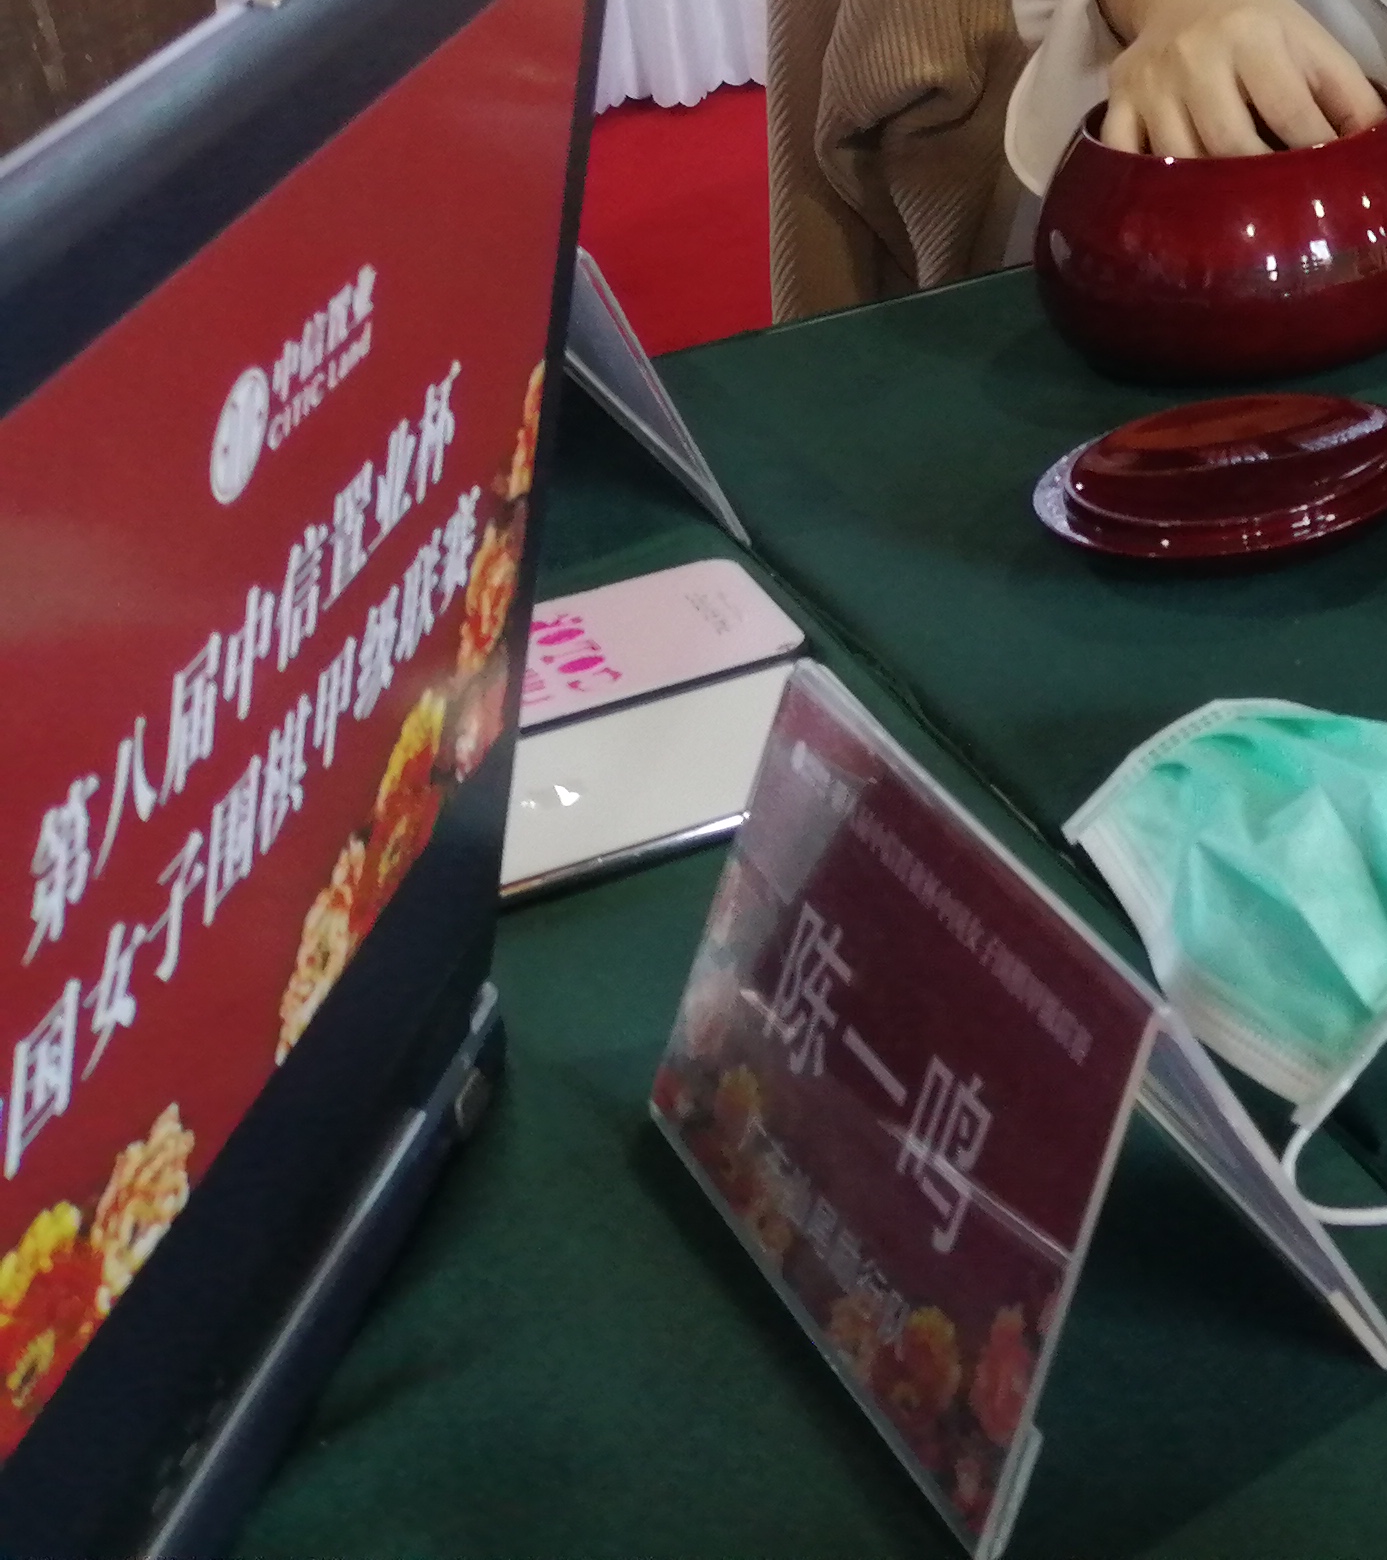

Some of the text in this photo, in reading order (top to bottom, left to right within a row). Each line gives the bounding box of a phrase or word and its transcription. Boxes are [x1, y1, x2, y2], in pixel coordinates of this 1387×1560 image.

[0, 485, 480, 1180] 国女子围棋甲级联赛
[21, 359, 461, 967] 第八届中信置业杯
[762, 899, 994, 1254] 陈一鸣
